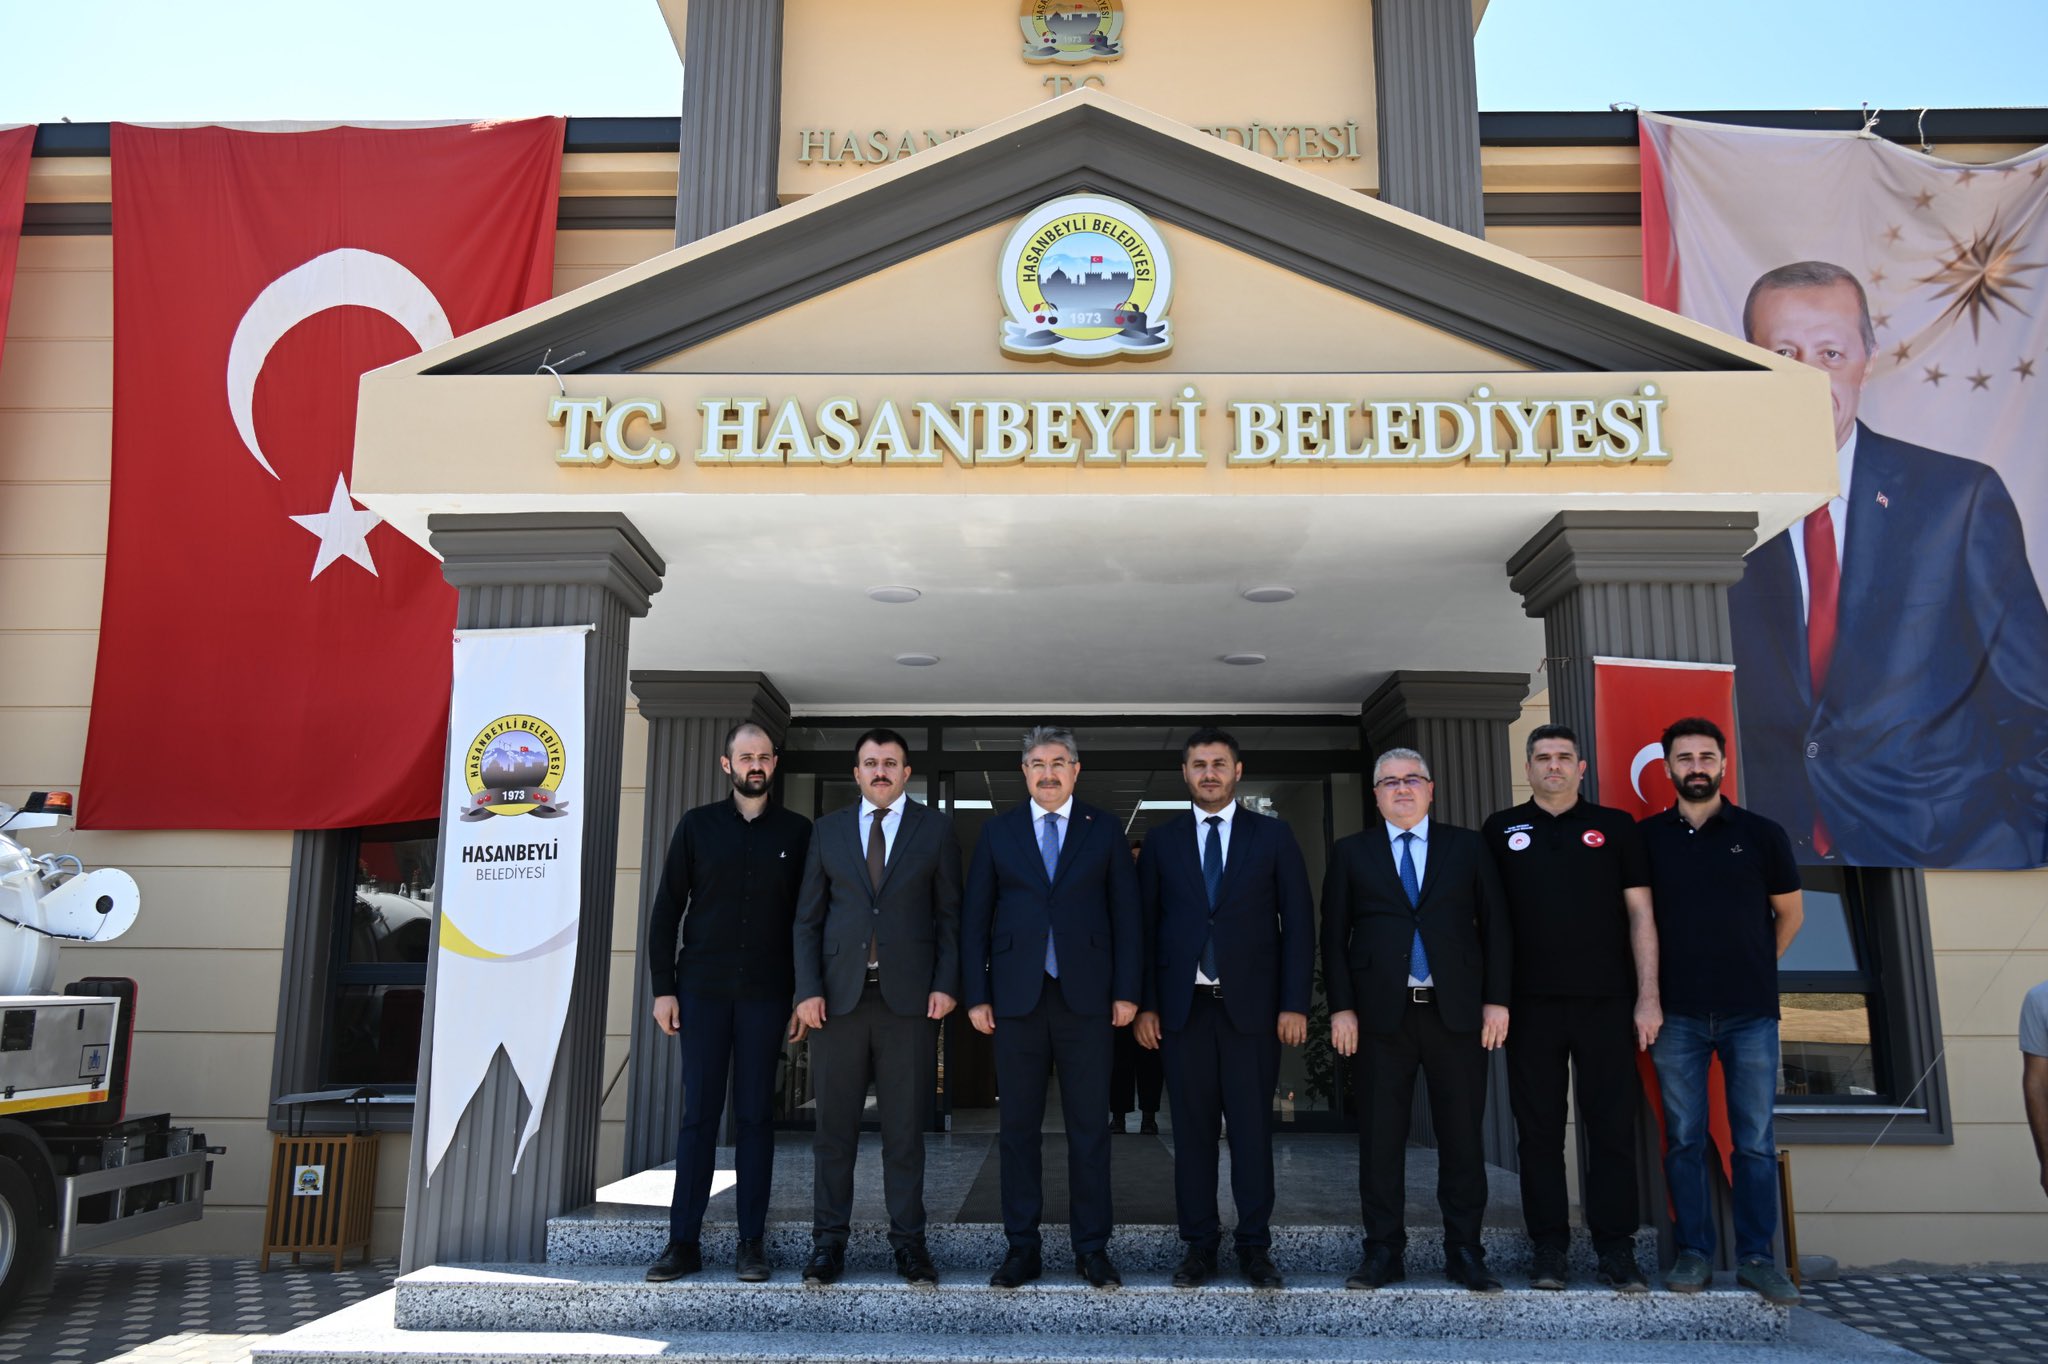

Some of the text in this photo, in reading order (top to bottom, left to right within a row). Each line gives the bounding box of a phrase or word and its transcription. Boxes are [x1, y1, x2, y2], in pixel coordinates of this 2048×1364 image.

[1022, 215, 1153, 282] HASANBEYLİ BELEDİYESİ
[1070, 312, 1102, 325] 1973
[547, 380, 1672, 468] T.C. HASANBEYLİ BELEDİYESİ
[470, 718, 561, 778] HASANBEYLİ BELEDİYESİ
[502, 790, 525, 801] 1973
[462, 838, 558, 863] HASANBEYLİ
[476, 864, 546, 881] BELEDİYESİ
